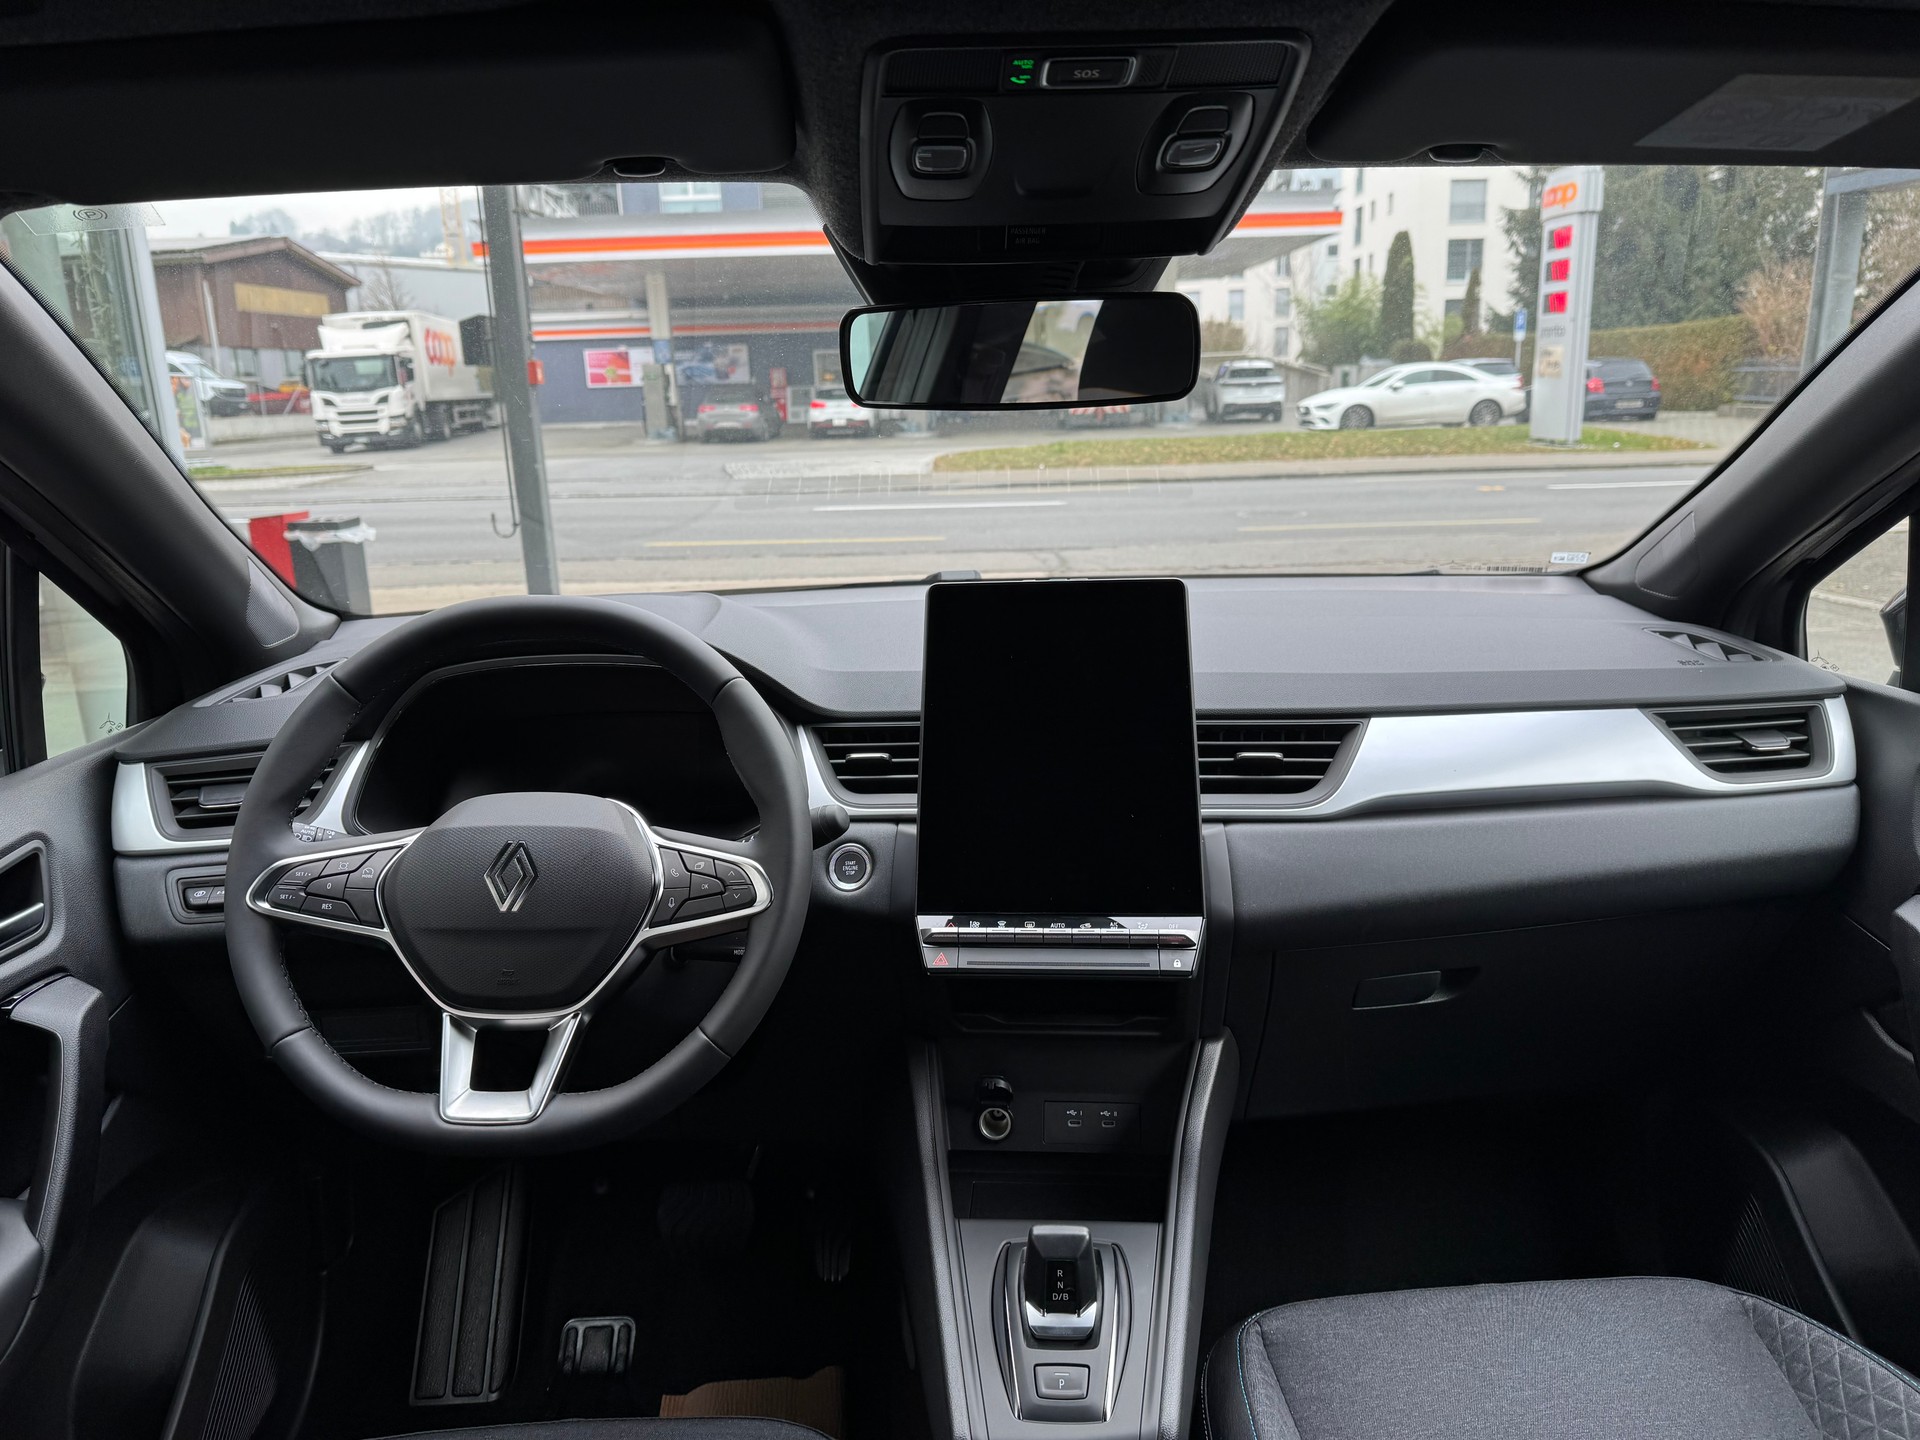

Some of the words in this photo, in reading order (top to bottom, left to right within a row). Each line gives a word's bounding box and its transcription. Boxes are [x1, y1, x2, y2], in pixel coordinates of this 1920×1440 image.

[1073, 69, 1101, 79] SOS
[424, 327, 456, 377] coop
[300, 828, 315, 836] AUTO
[1057, 1269, 1064, 1277] R
[1057, 1281, 1064, 1289] N
[1052, 1292, 1069, 1301] D/B
[1058, 1379, 1065, 1389] P
